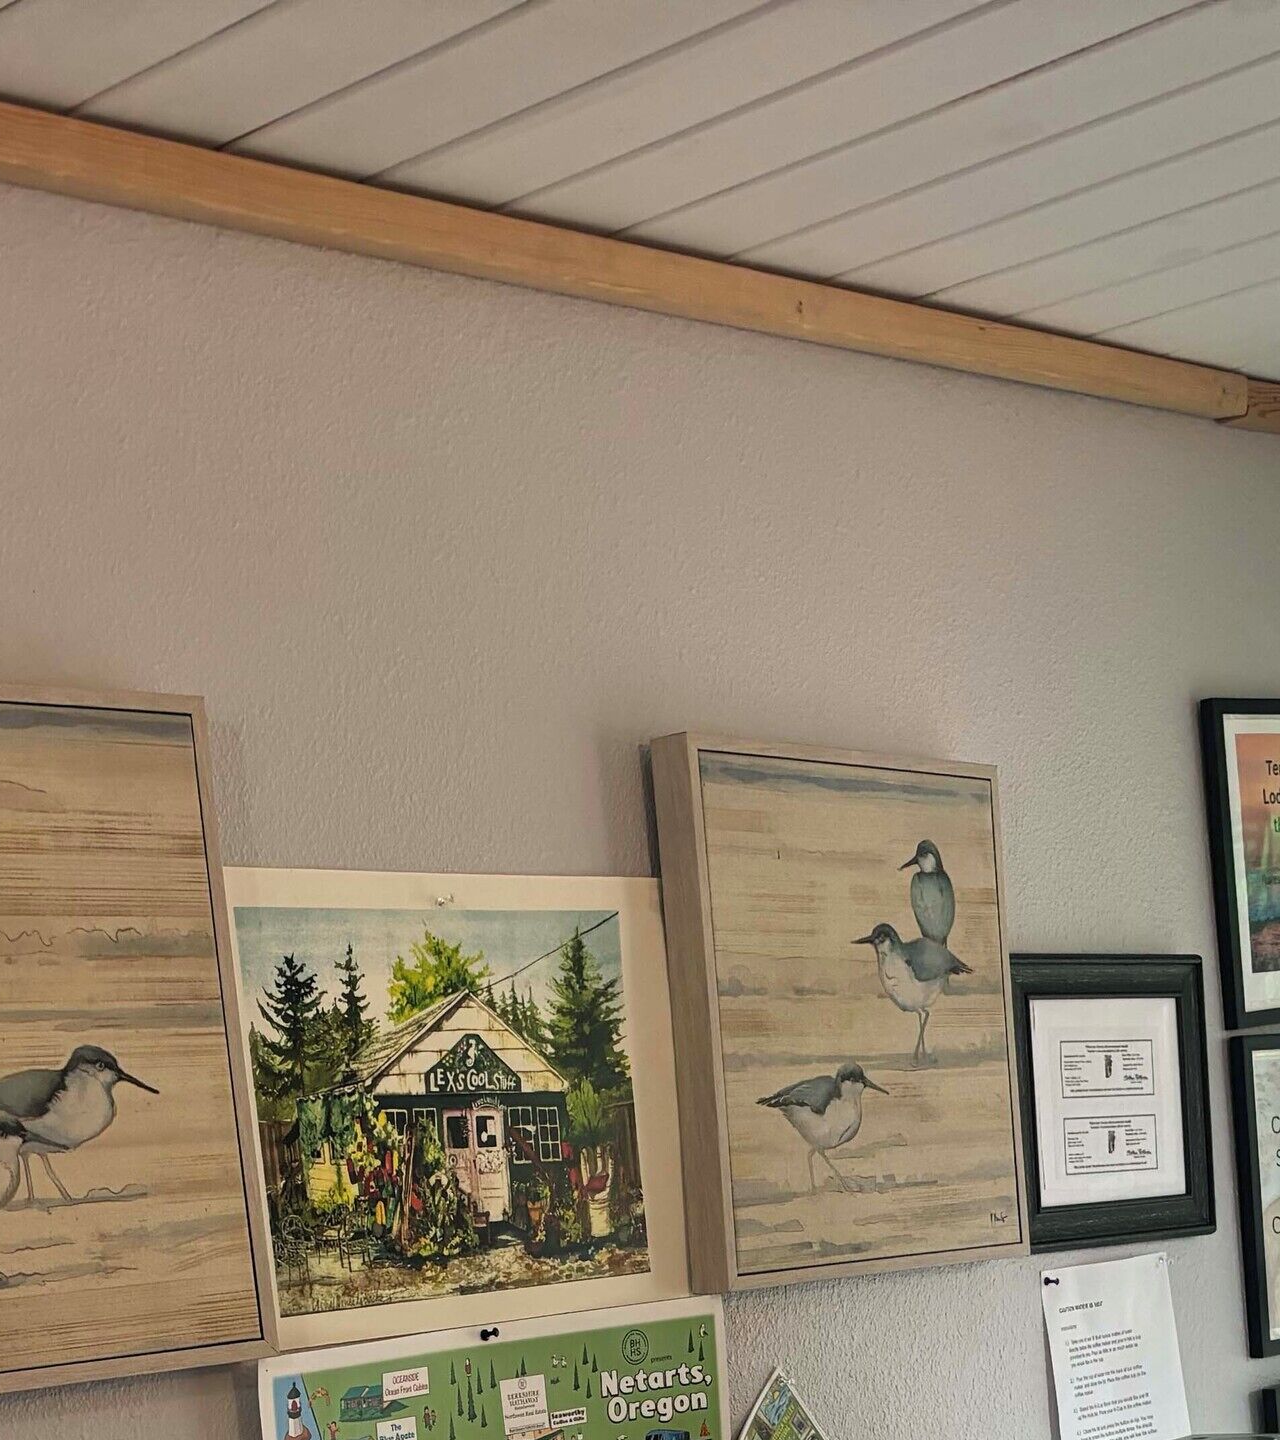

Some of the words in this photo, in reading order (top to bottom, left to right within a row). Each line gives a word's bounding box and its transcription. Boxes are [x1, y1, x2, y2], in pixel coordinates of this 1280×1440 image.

[600, 1363, 712, 1398] Netarts,
[607, 1391, 708, 1423] Oregon
[391, 1423, 401, 1431] The
